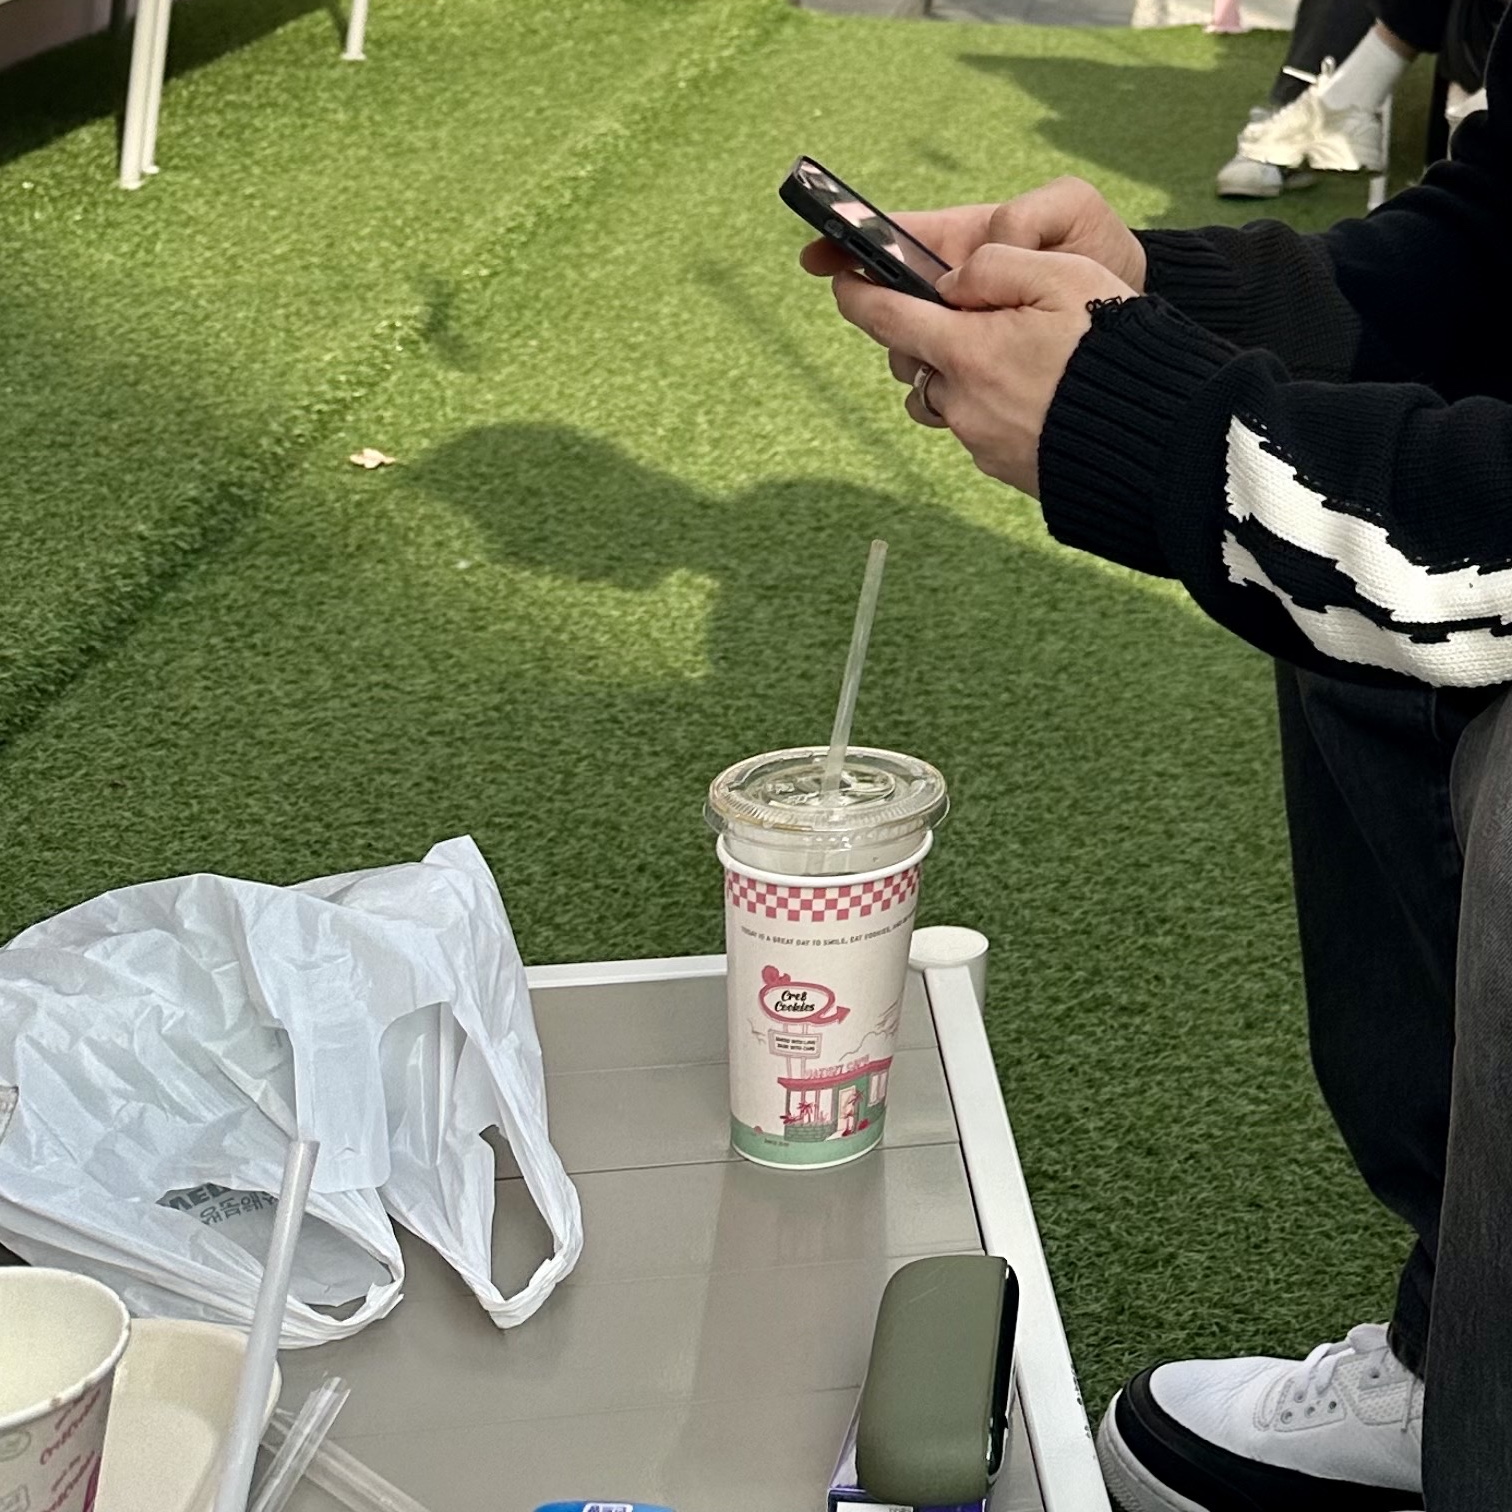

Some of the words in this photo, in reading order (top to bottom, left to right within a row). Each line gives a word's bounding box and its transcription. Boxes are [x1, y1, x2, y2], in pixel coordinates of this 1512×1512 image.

[796, 938, 810, 946] DAY
[812, 938, 821, 946] TO
[774, 1000, 816, 1013] Cookies
